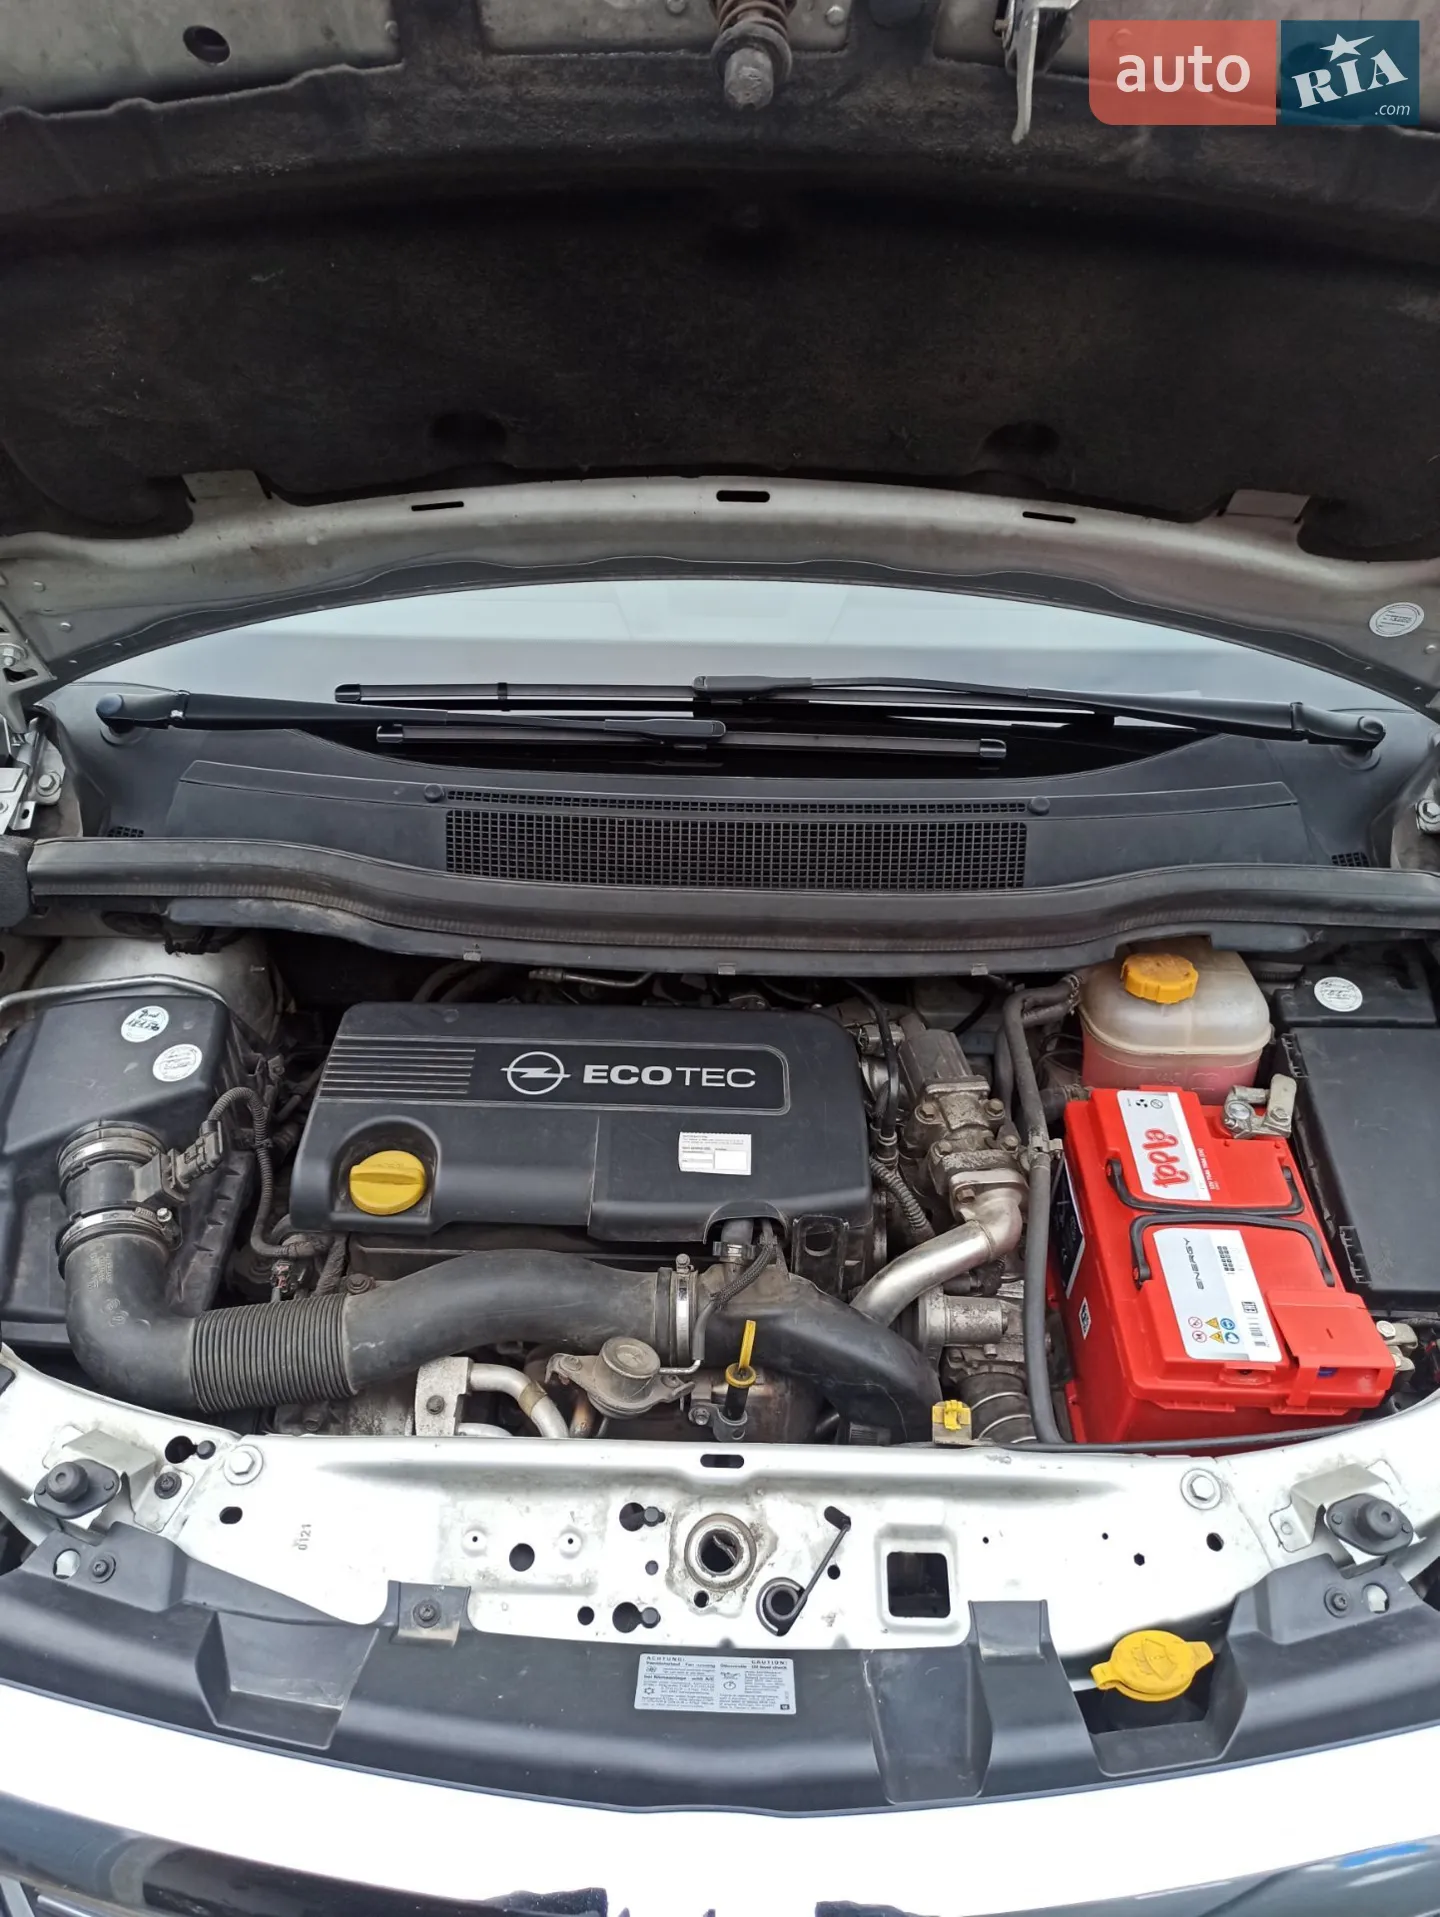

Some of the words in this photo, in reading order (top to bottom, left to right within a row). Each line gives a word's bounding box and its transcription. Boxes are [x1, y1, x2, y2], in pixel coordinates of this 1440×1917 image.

[583, 1064, 756, 1088] ECOTEC
[1142, 1127, 1191, 1188] topla
[1183, 1237, 1205, 1290] ENERGY
[298, 1524, 311, 1550] 0121
